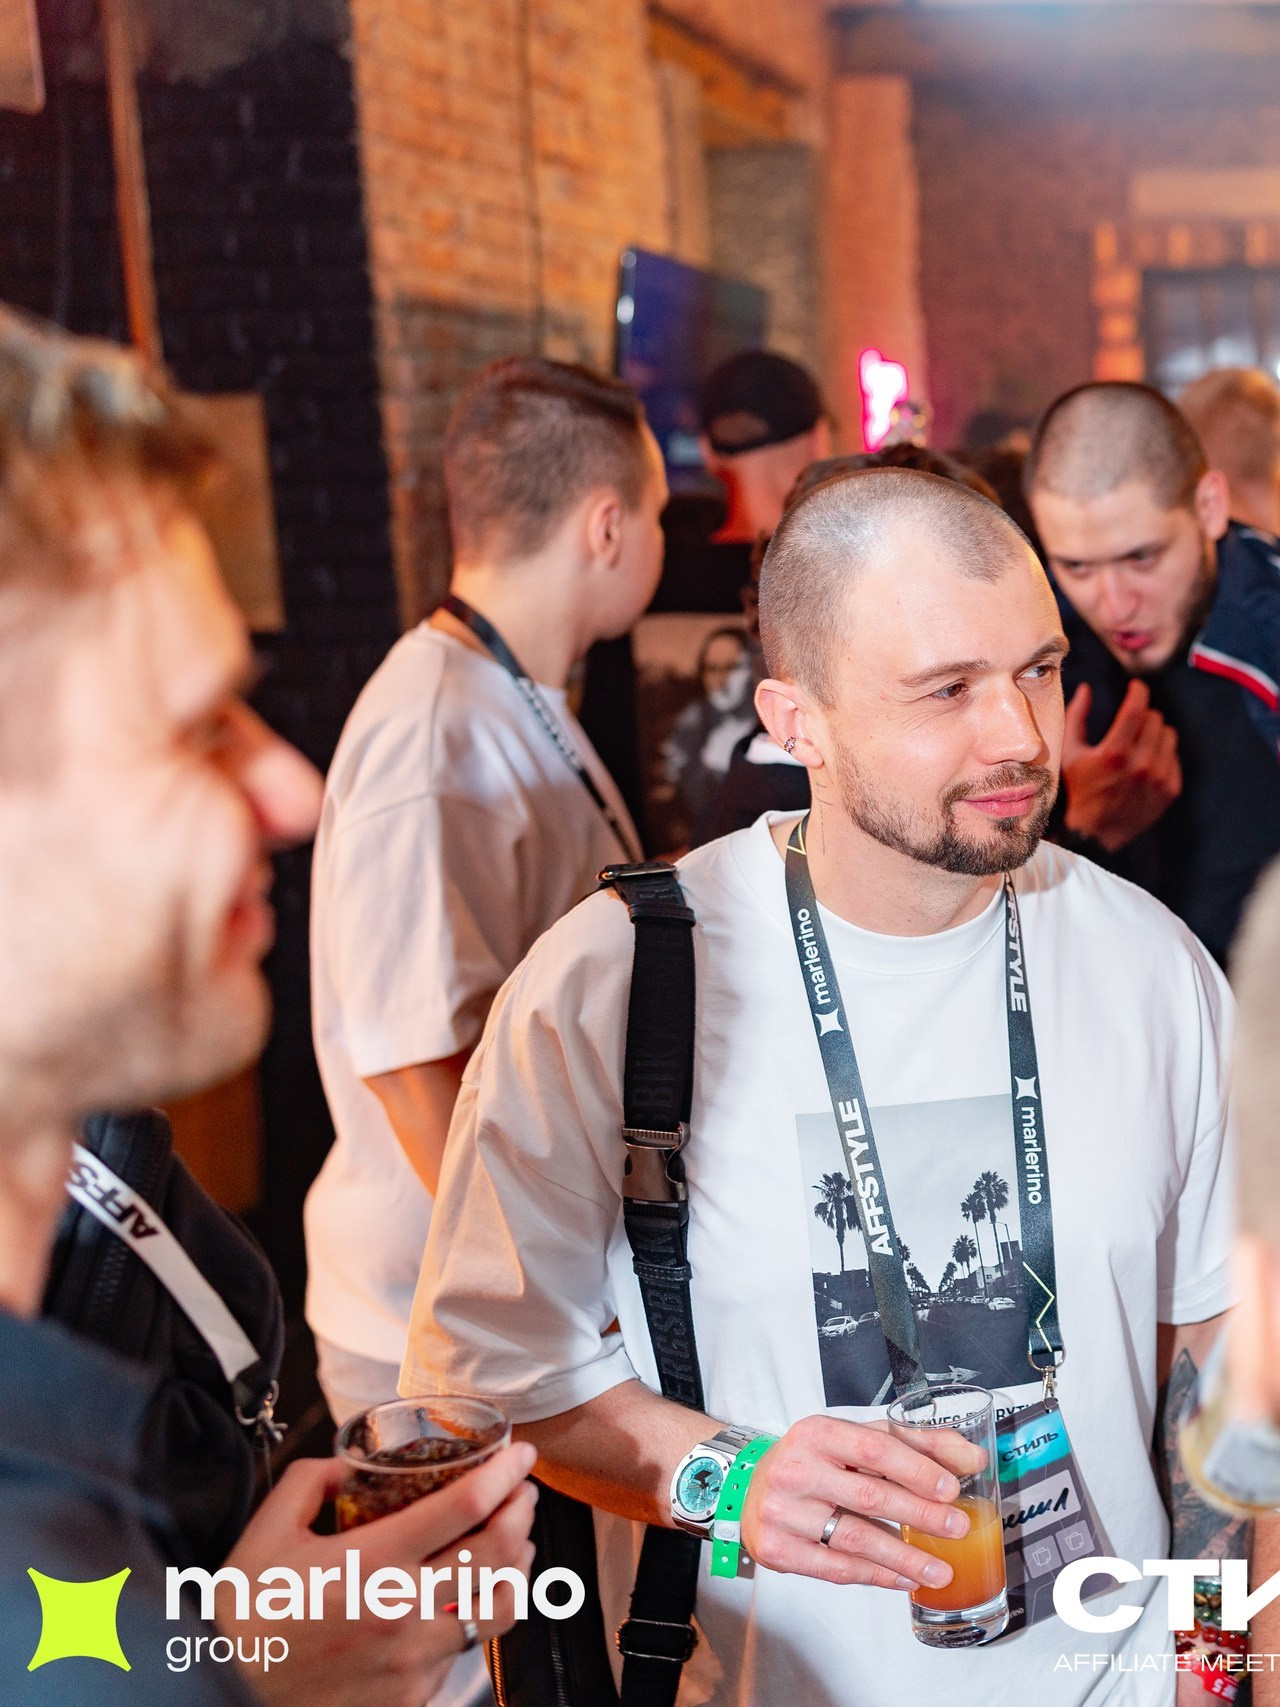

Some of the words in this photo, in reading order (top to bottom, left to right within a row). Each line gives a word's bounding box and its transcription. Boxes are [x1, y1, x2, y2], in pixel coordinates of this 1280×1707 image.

[797, 907, 831, 1006] marlerino
[838, 1098, 894, 1257] AFFSTYLE
[1020, 1106, 1043, 1206] marlerino
[1001, 1432, 1059, 1463] СТИЛЬ
